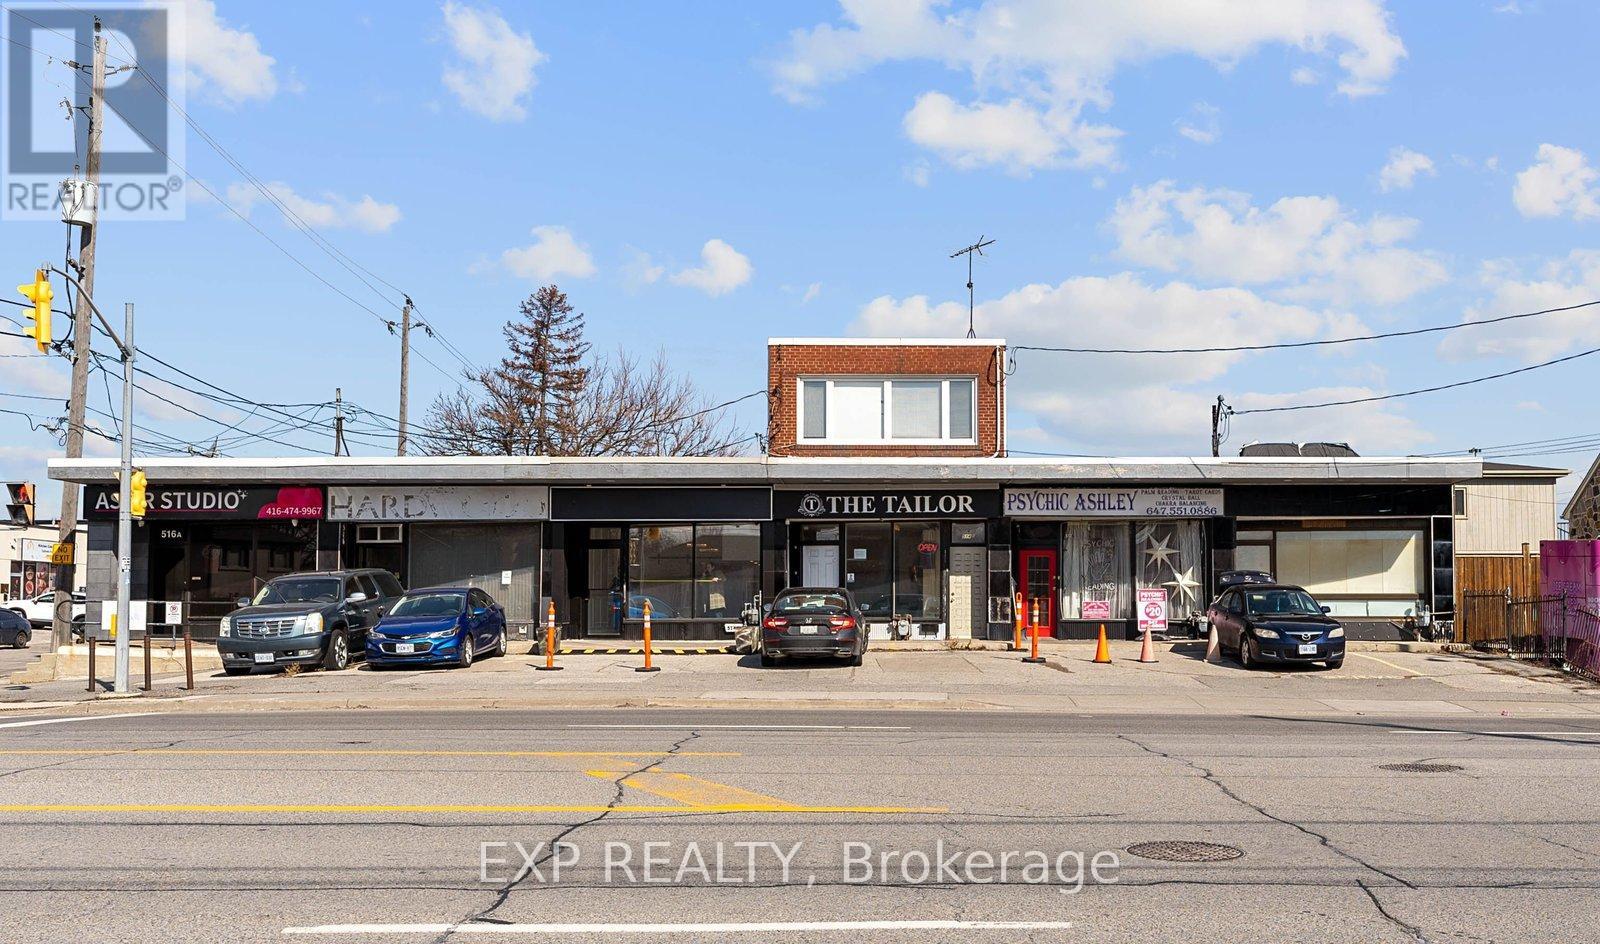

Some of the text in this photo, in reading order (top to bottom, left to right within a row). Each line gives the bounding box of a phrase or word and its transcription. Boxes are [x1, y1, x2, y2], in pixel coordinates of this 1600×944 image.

[95, 491, 239, 510] ASR STUDIO
[826, 495, 975, 514] THE TAILOR
[1007, 489, 1139, 511] PSYCHIC ASHLEY
[266, 506, 322, 516] 416-474-9967
[1146, 506, 1217, 516] 647.551.0886
[161, 530, 182, 539] 516A
[917, 543, 938, 553] OPEN
[54, 554, 70, 562] EXIT
